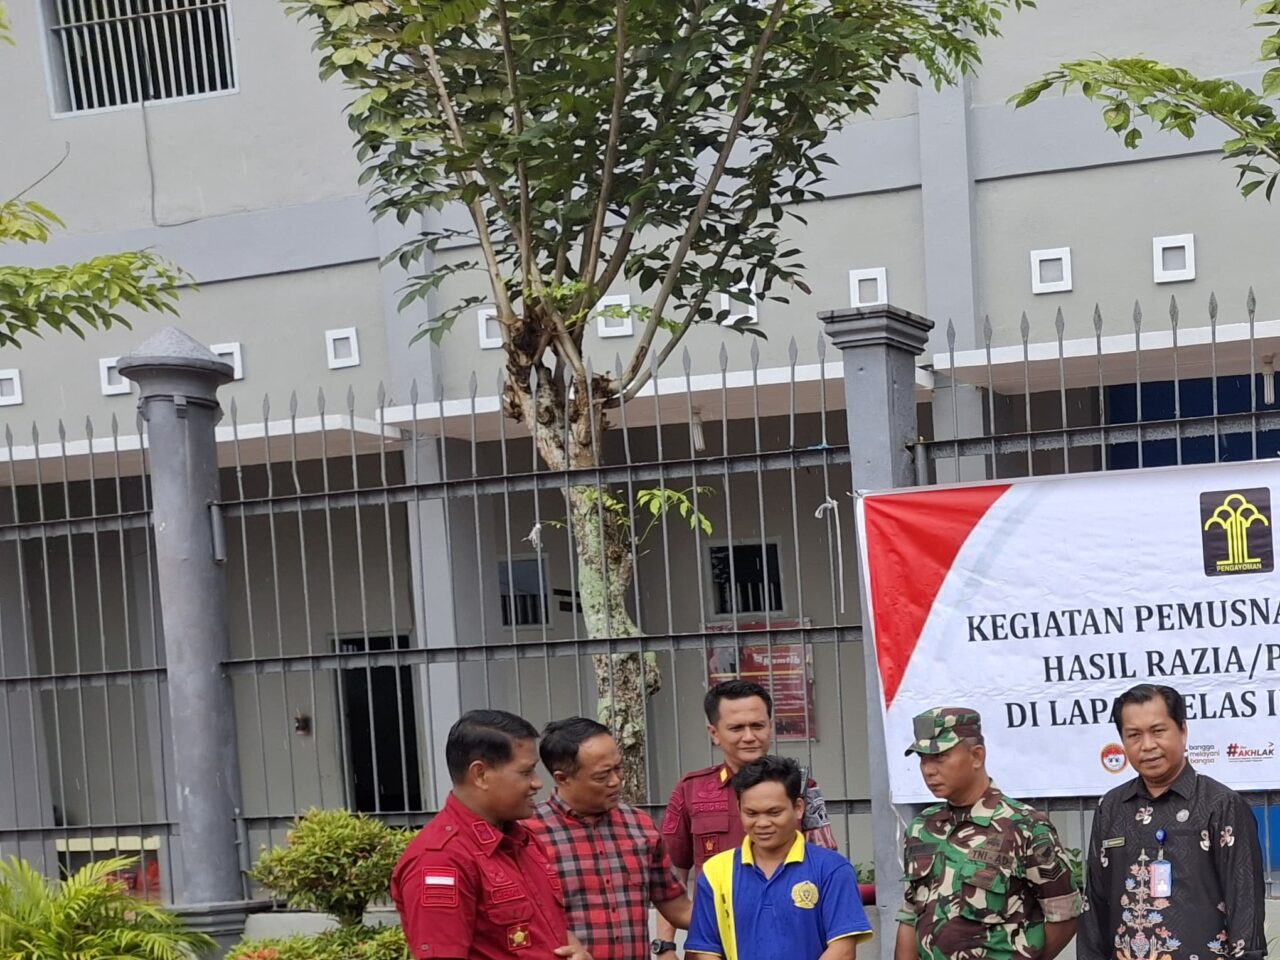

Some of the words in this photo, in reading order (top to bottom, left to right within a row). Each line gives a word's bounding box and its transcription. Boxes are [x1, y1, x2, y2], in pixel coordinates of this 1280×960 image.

[1217, 562, 1261, 573] PENGAYOMAN
[967, 606, 1124, 642] KEGIATAN
[1043, 651, 1137, 682] HASIL
[1005, 701, 1040, 728] DI
[1184, 689, 1257, 721] ELAS
[1189, 744, 1215, 753] bangga
[1190, 750, 1220, 759] melayani
[1190, 757, 1215, 766] bangsa
